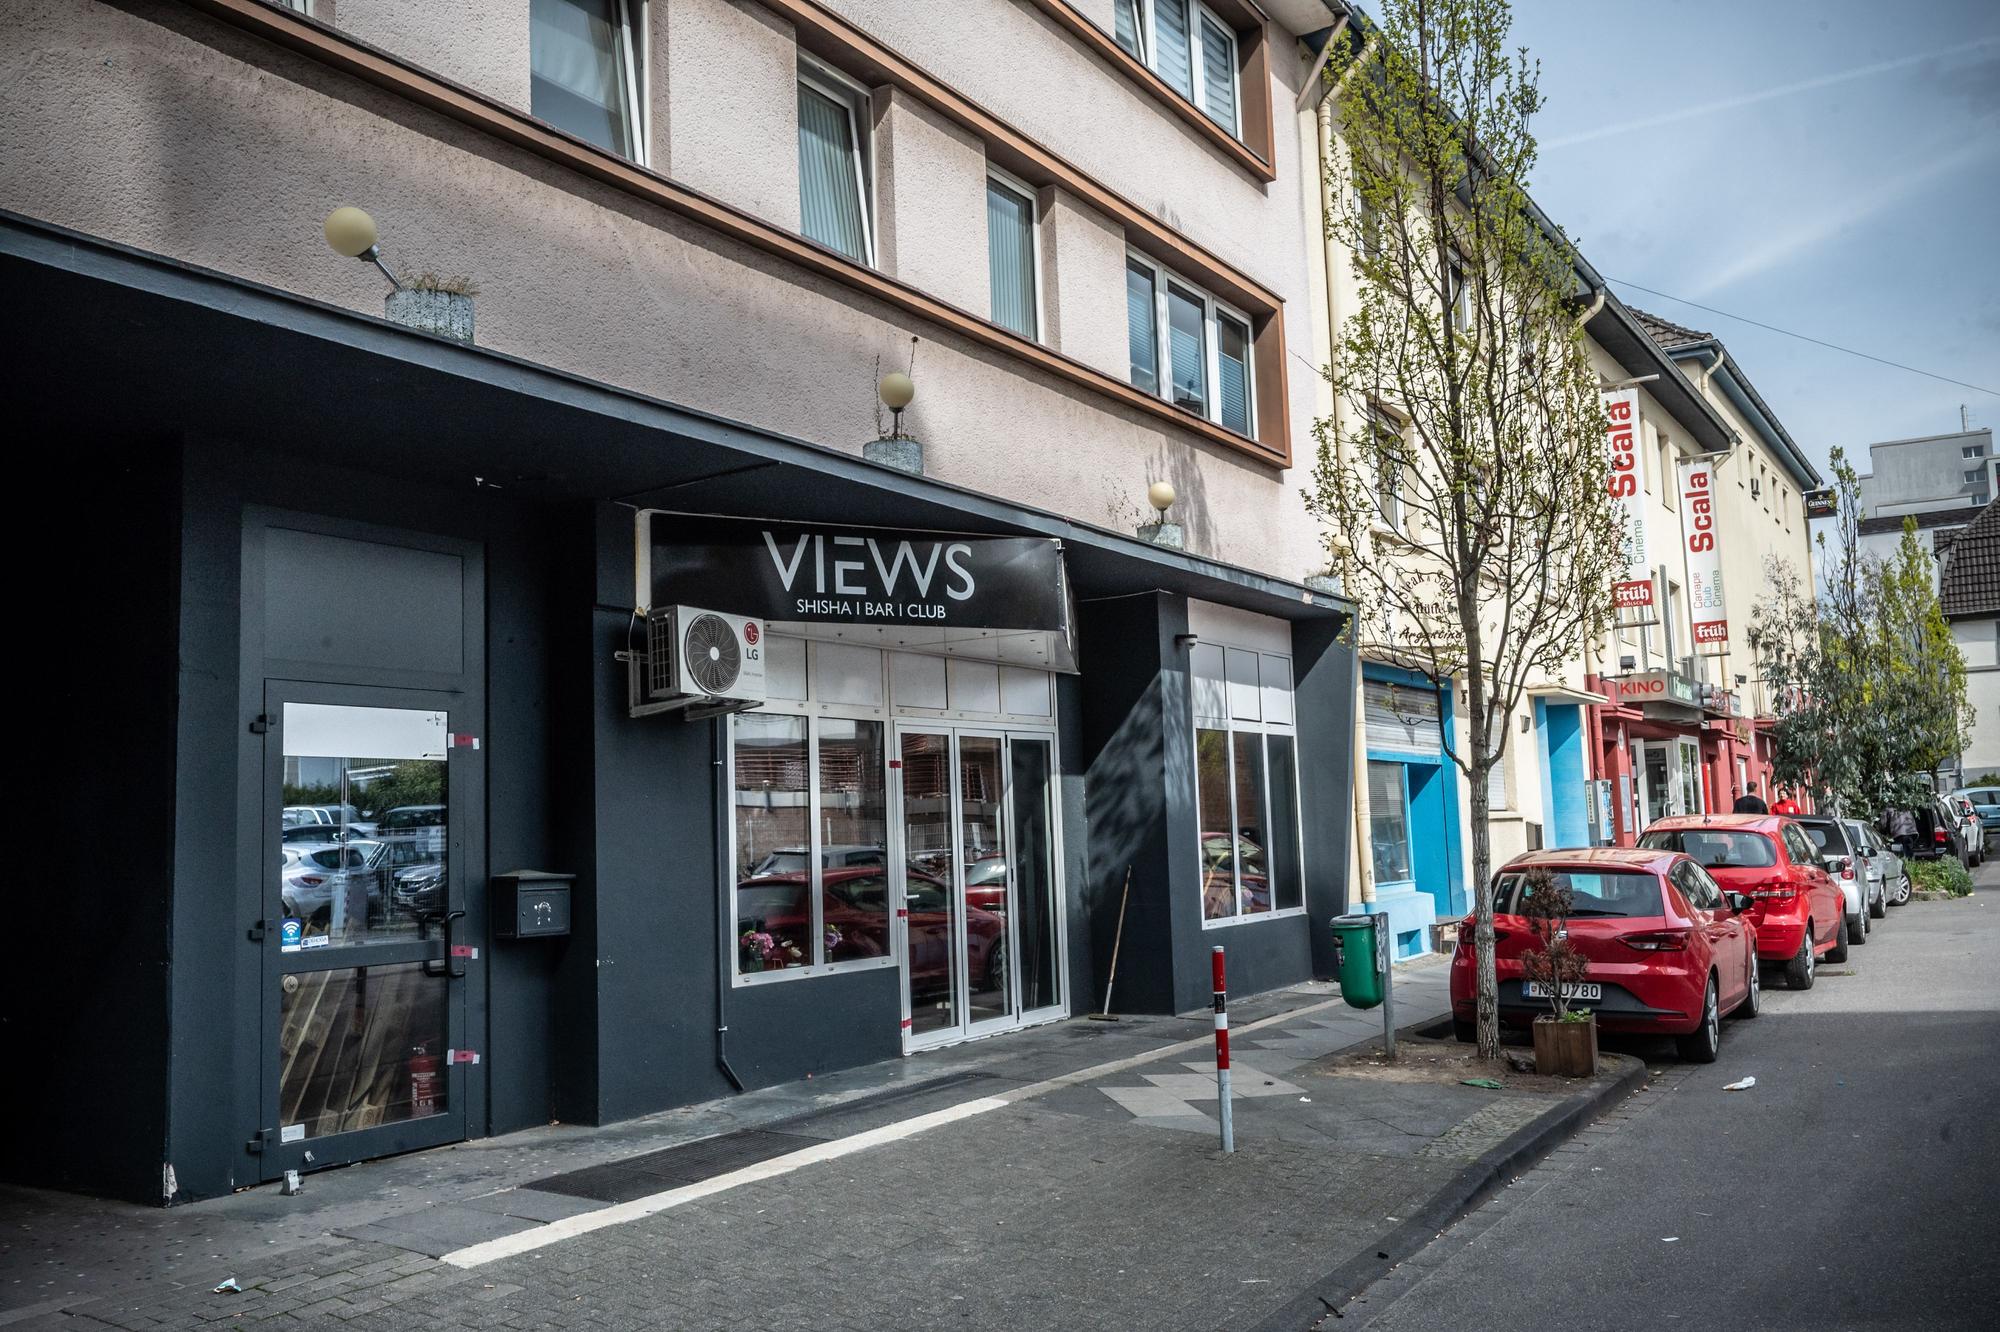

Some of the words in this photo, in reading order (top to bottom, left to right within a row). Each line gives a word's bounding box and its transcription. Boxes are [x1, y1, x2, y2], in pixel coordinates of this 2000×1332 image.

[1605, 401, 1637, 498] Scala
[1685, 472, 1713, 552] Scala
[1633, 519, 1645, 564] Cinema
[762, 531, 975, 600] VIEWS
[1616, 584, 1649, 602] früh
[1693, 572, 1703, 609] Canape
[1703, 586, 1713, 609] Club
[1713, 570, 1722, 608] Cinema
[797, 599, 852, 615] SHISHA
[865, 602, 895, 617] BAR
[907, 603, 946, 619] CLUB
[1697, 623, 1727, 639] früh
[746, 648, 759, 660] LG
[1620, 680, 1665, 695] KINO
